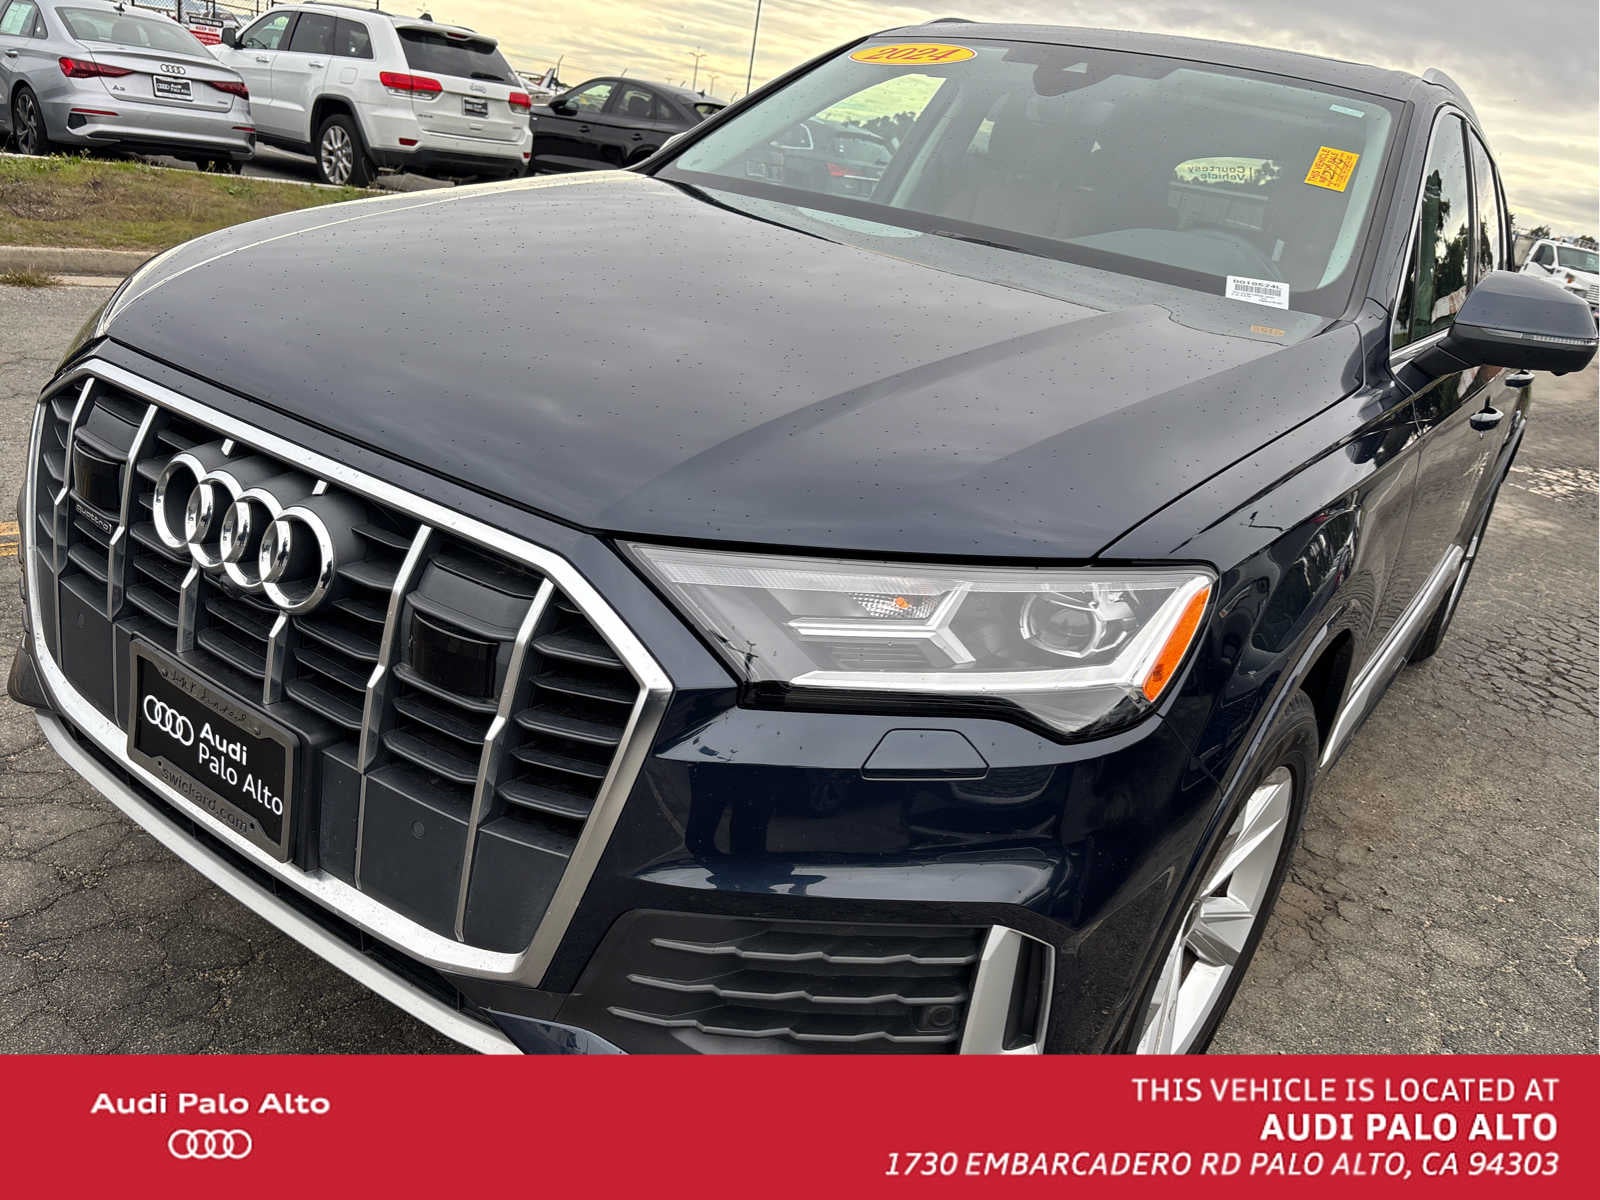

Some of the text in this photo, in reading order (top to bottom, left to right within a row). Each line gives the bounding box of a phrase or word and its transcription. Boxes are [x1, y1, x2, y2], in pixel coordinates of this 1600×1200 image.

[864, 47, 961, 61] 2024
[199, 722, 247, 766] Audi
[161, 767, 249, 832] swickard.com
[198, 743, 283, 816] Palo Alto
